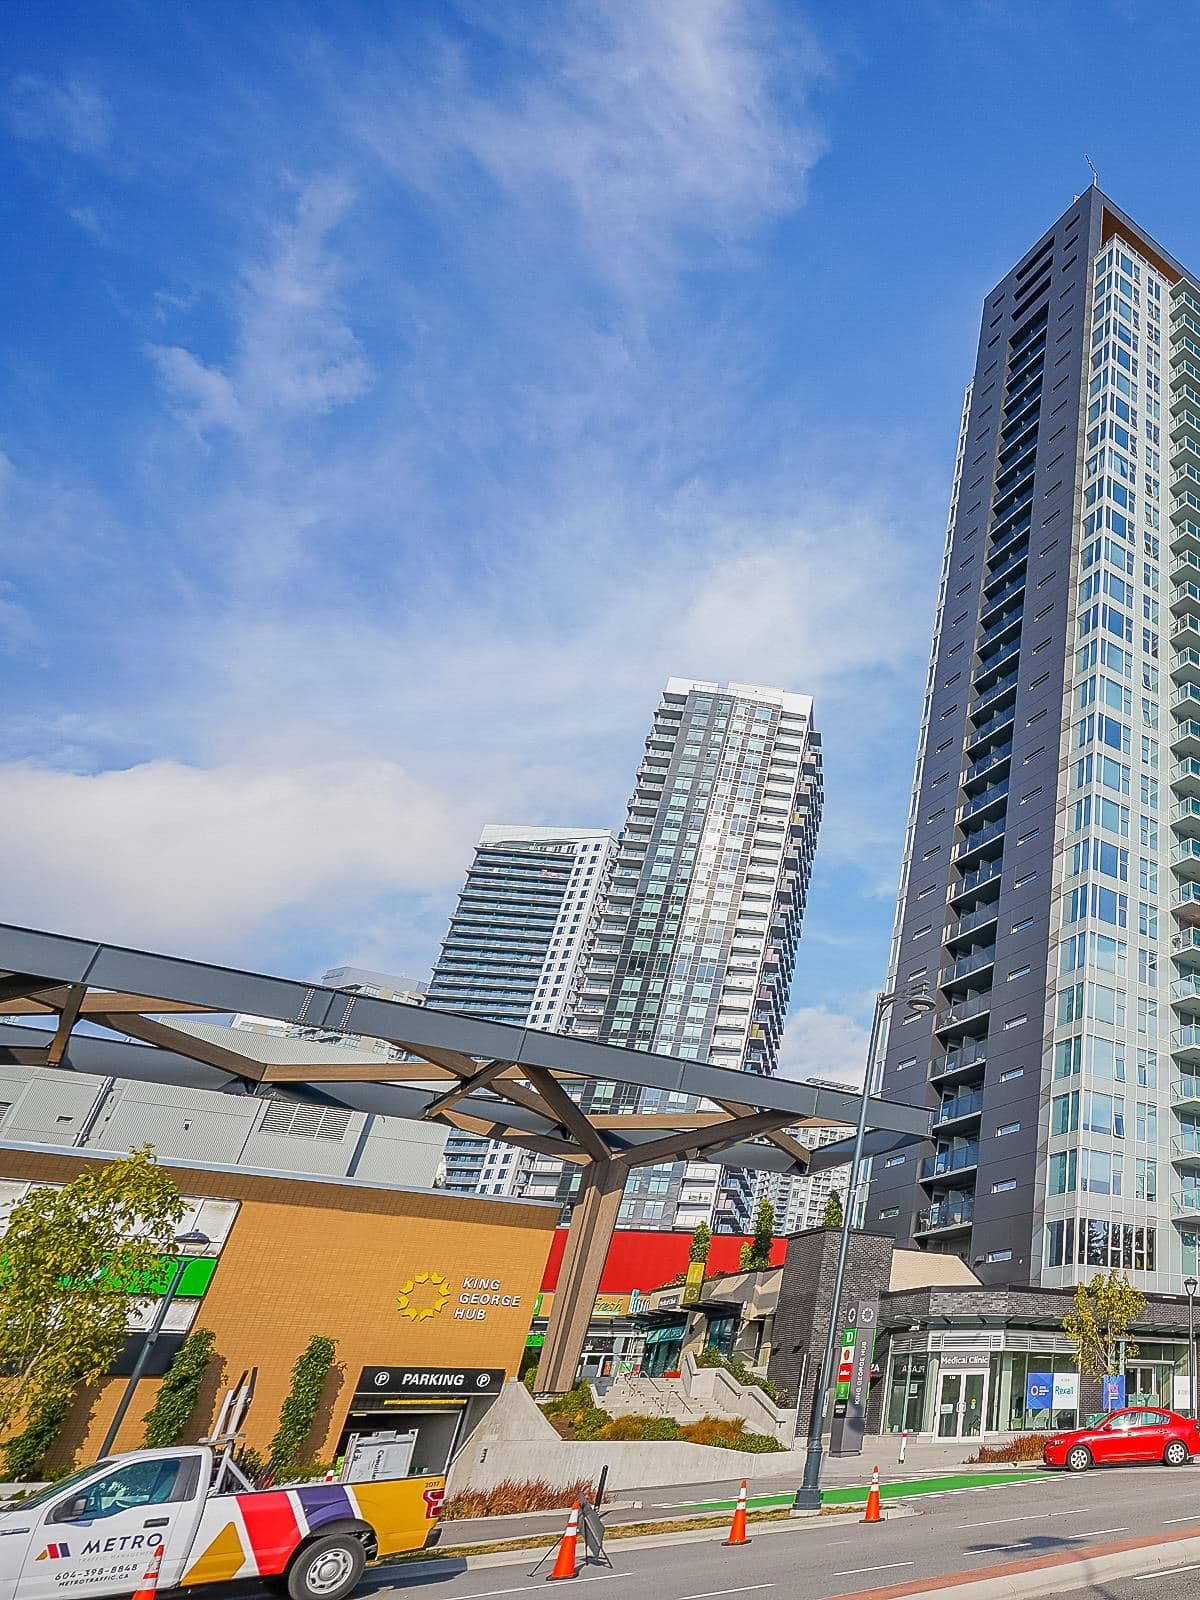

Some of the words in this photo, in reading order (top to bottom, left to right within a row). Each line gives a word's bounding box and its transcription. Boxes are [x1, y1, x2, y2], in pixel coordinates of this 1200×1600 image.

[463, 1277, 501, 1291] KING
[459, 1292, 521, 1308] GEORGE
[454, 1308, 486, 1321] HUB
[941, 1355, 968, 1365] Medical
[968, 1355, 989, 1364] Clinic
[856, 1357, 866, 1386] GEORGE
[401, 1373, 465, 1386] PARKING
[854, 1387, 863, 1405] KING
[424, 1480, 441, 1488] 2017
[80, 1533, 163, 1555] METRO
[54, 1563, 138, 1580] 604-398-8848
[58, 1573, 129, 1587] METROTRAFFIC.CA
